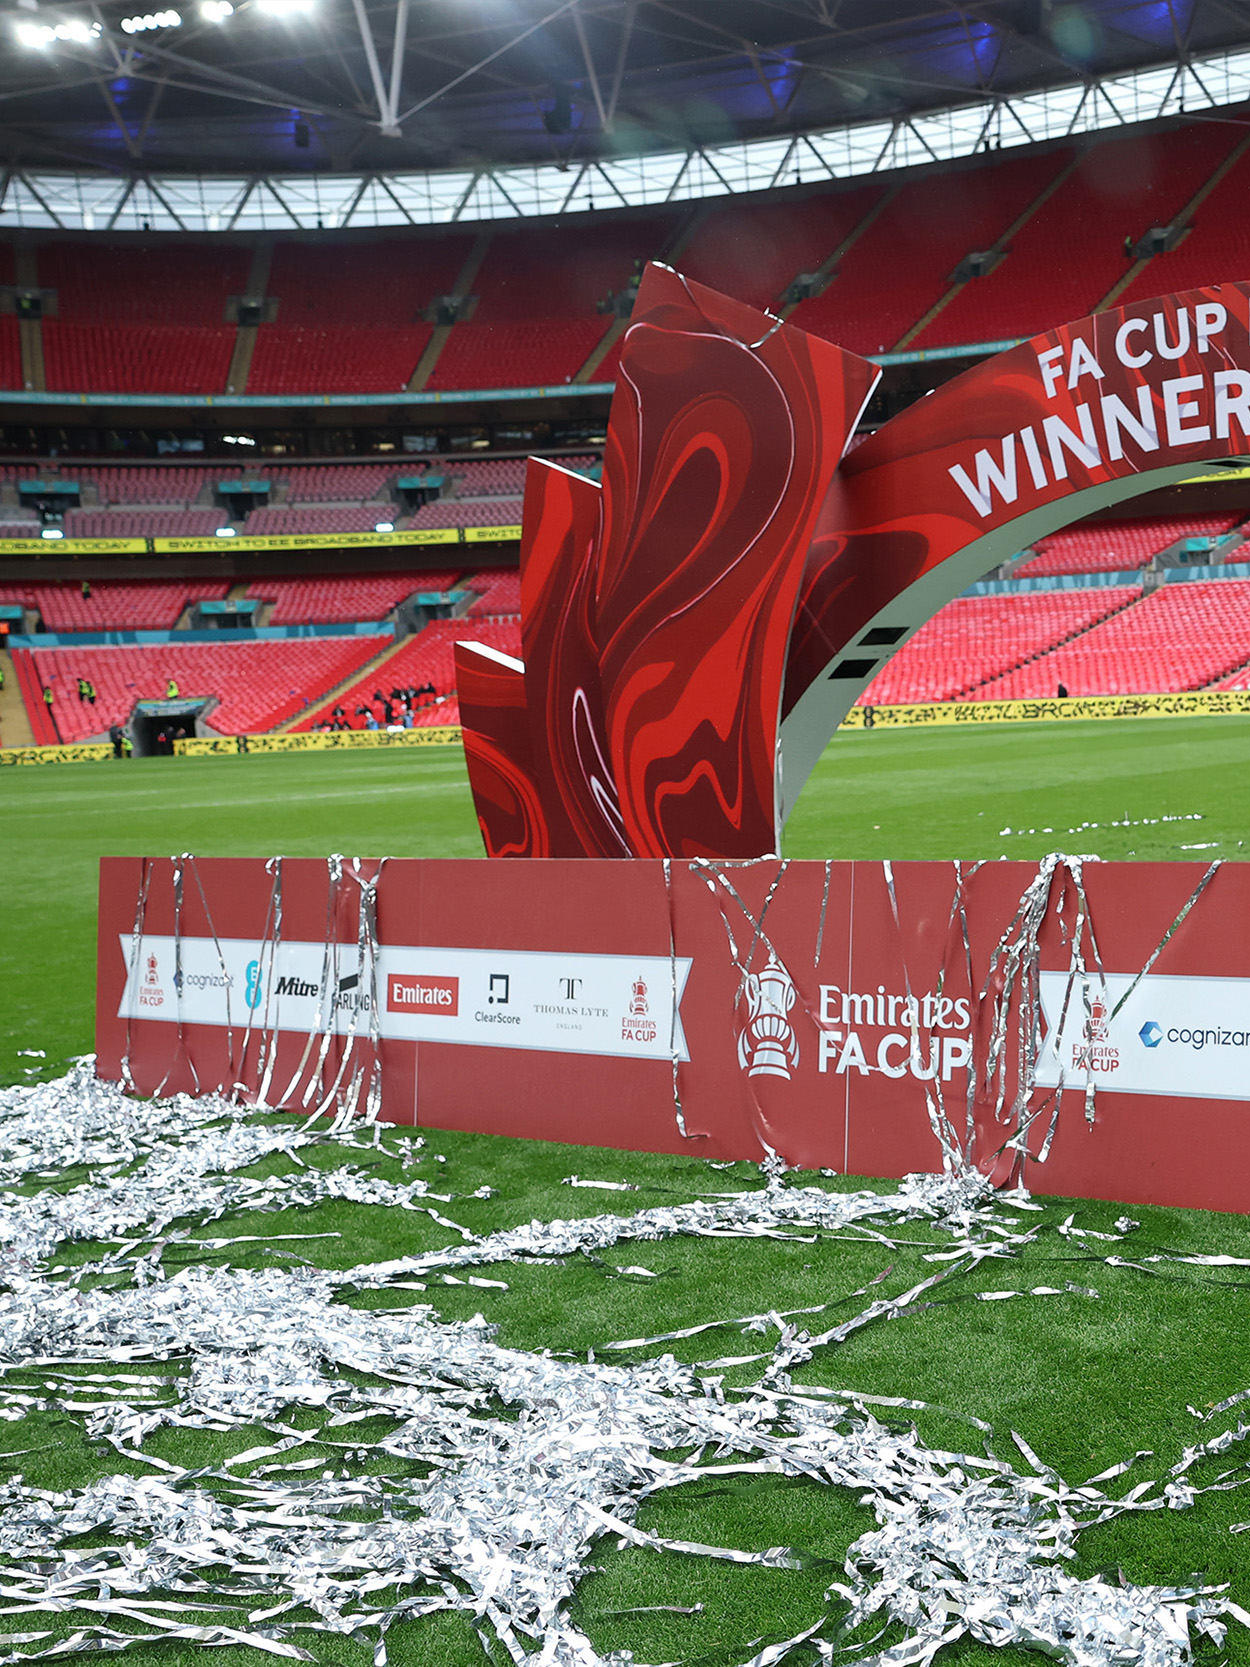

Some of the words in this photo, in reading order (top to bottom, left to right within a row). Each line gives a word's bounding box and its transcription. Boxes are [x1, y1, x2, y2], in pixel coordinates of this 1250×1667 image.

[1036, 337, 1105, 399] FA
[1115, 302, 1228, 369] CUP
[274, 976, 318, 997] Mitre
[393, 983, 452, 1006] Emirates
[533, 1004, 578, 1016] THOMAS
[580, 1007, 609, 1018] LYTE
[818, 984, 970, 1030] Emirates
[474, 1010, 521, 1025] ClearScore
[621, 1017, 657, 1029] Emirates
[556, 1022, 583, 1031] ENGLAND
[621, 1029, 634, 1041] FA
[635, 1030, 657, 1042] CUP
[818, 1030, 866, 1076] FA
[877, 1033, 970, 1082] CUP
[1072, 1043, 1119, 1058] Emrates
[1090, 1058, 1119, 1072] CUP
